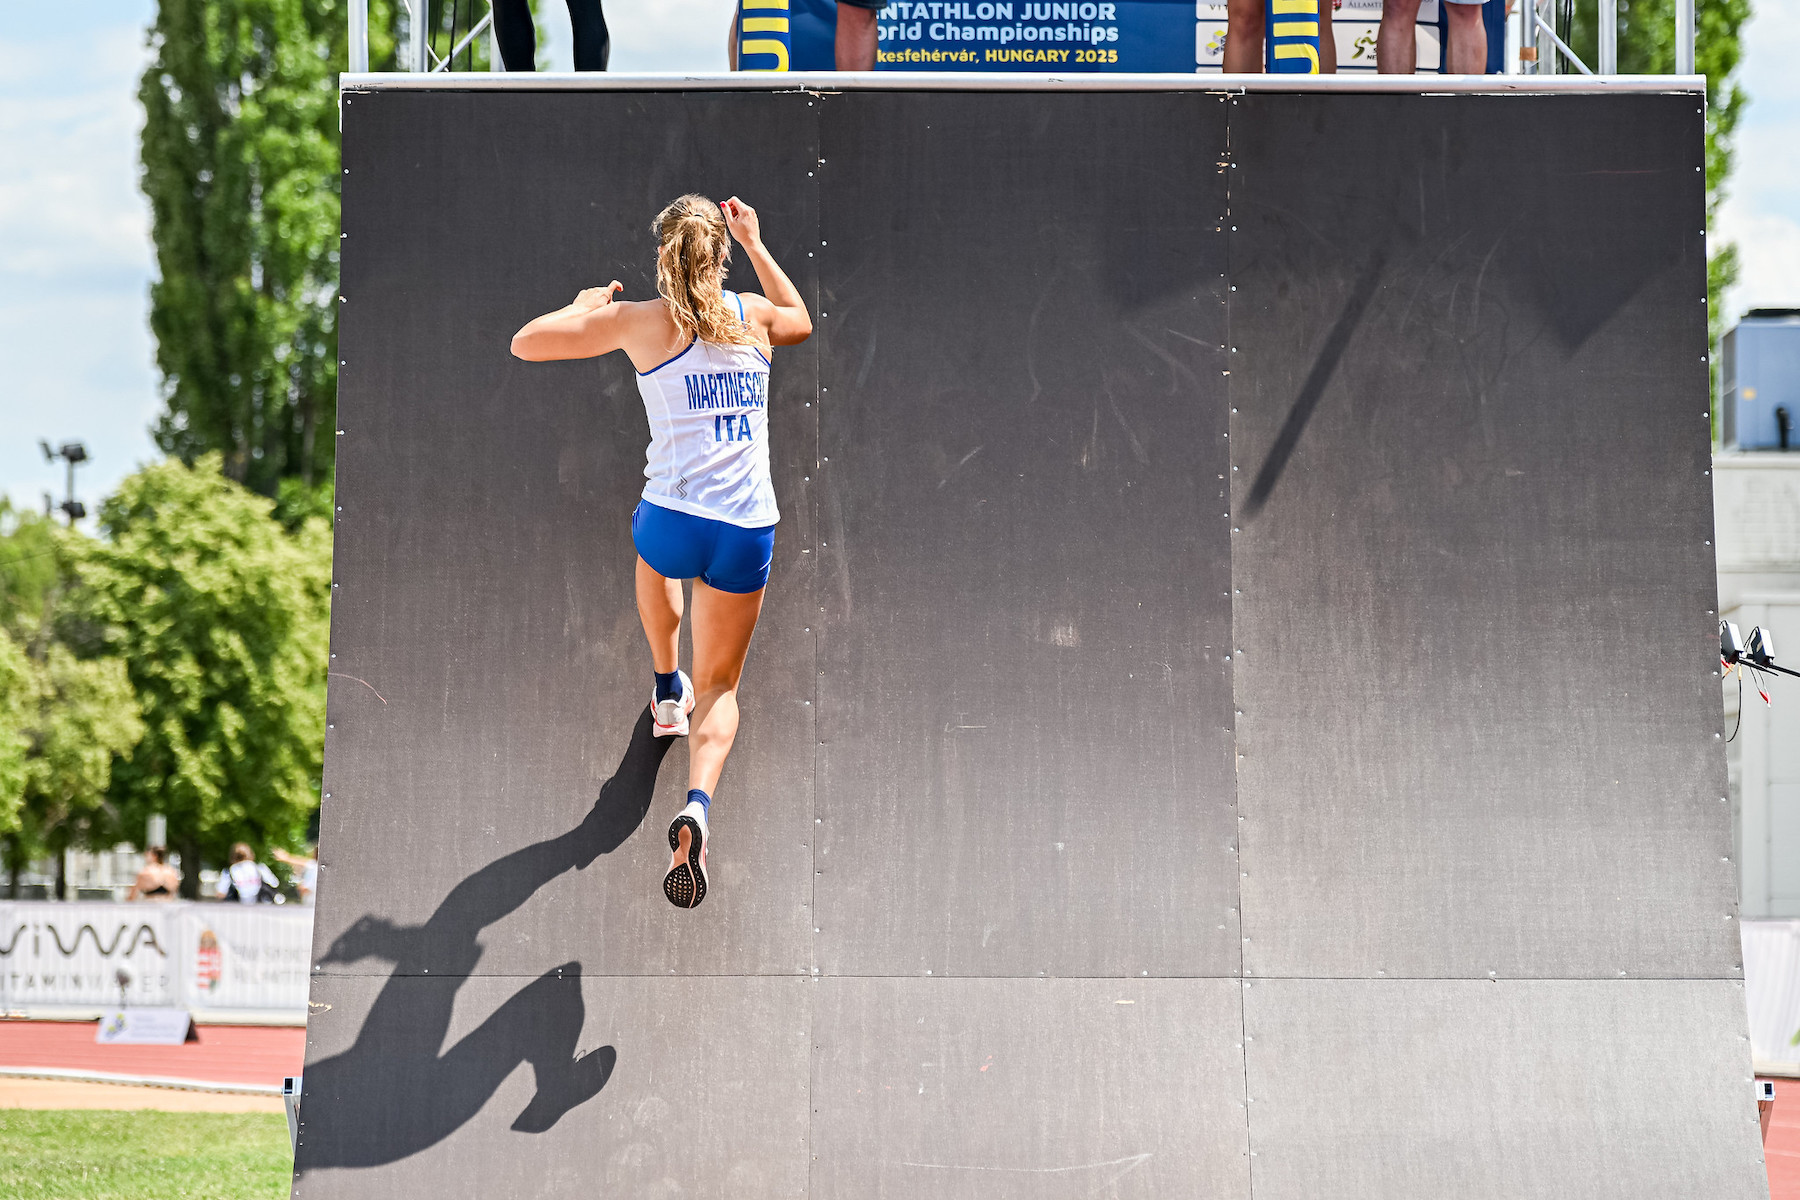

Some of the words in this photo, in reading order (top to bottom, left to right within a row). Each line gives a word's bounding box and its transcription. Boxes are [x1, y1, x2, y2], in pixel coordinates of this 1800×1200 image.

[876, 2, 1013, 20] NTATHLON
[1020, 2, 1117, 20] JUNIOR
[877, 22, 922, 41] orld
[929, 22, 1119, 45] Championships
[876, 48, 980, 64] kesfehérvár,
[985, 49, 1070, 63] HUNGARY
[1075, 49, 1119, 63] 2025
[715, 414, 753, 442] ITA
